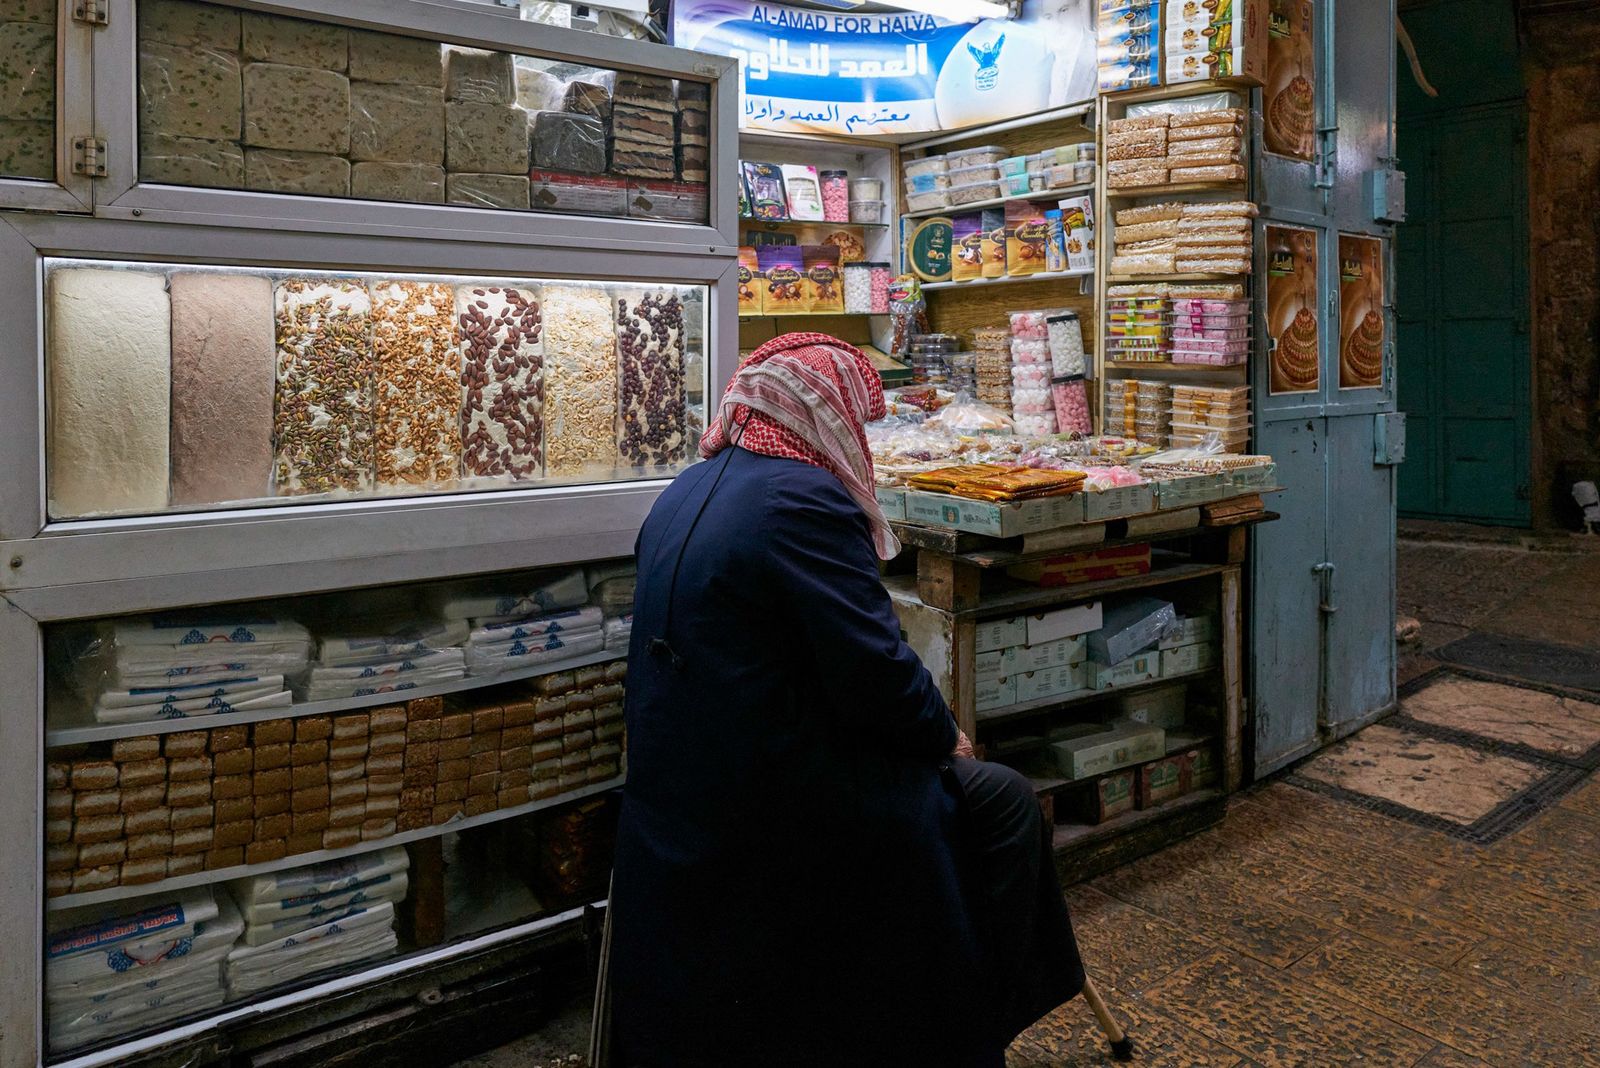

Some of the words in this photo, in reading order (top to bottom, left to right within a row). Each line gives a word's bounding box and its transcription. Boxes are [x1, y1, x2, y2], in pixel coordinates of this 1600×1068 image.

[752, 5, 828, 33] AL-AMAD
[834, 17, 871, 34] FOR
[879, 14, 938, 34] HALVA
[839, 42, 928, 78] العمد
[789, 103, 839, 122] العمد
